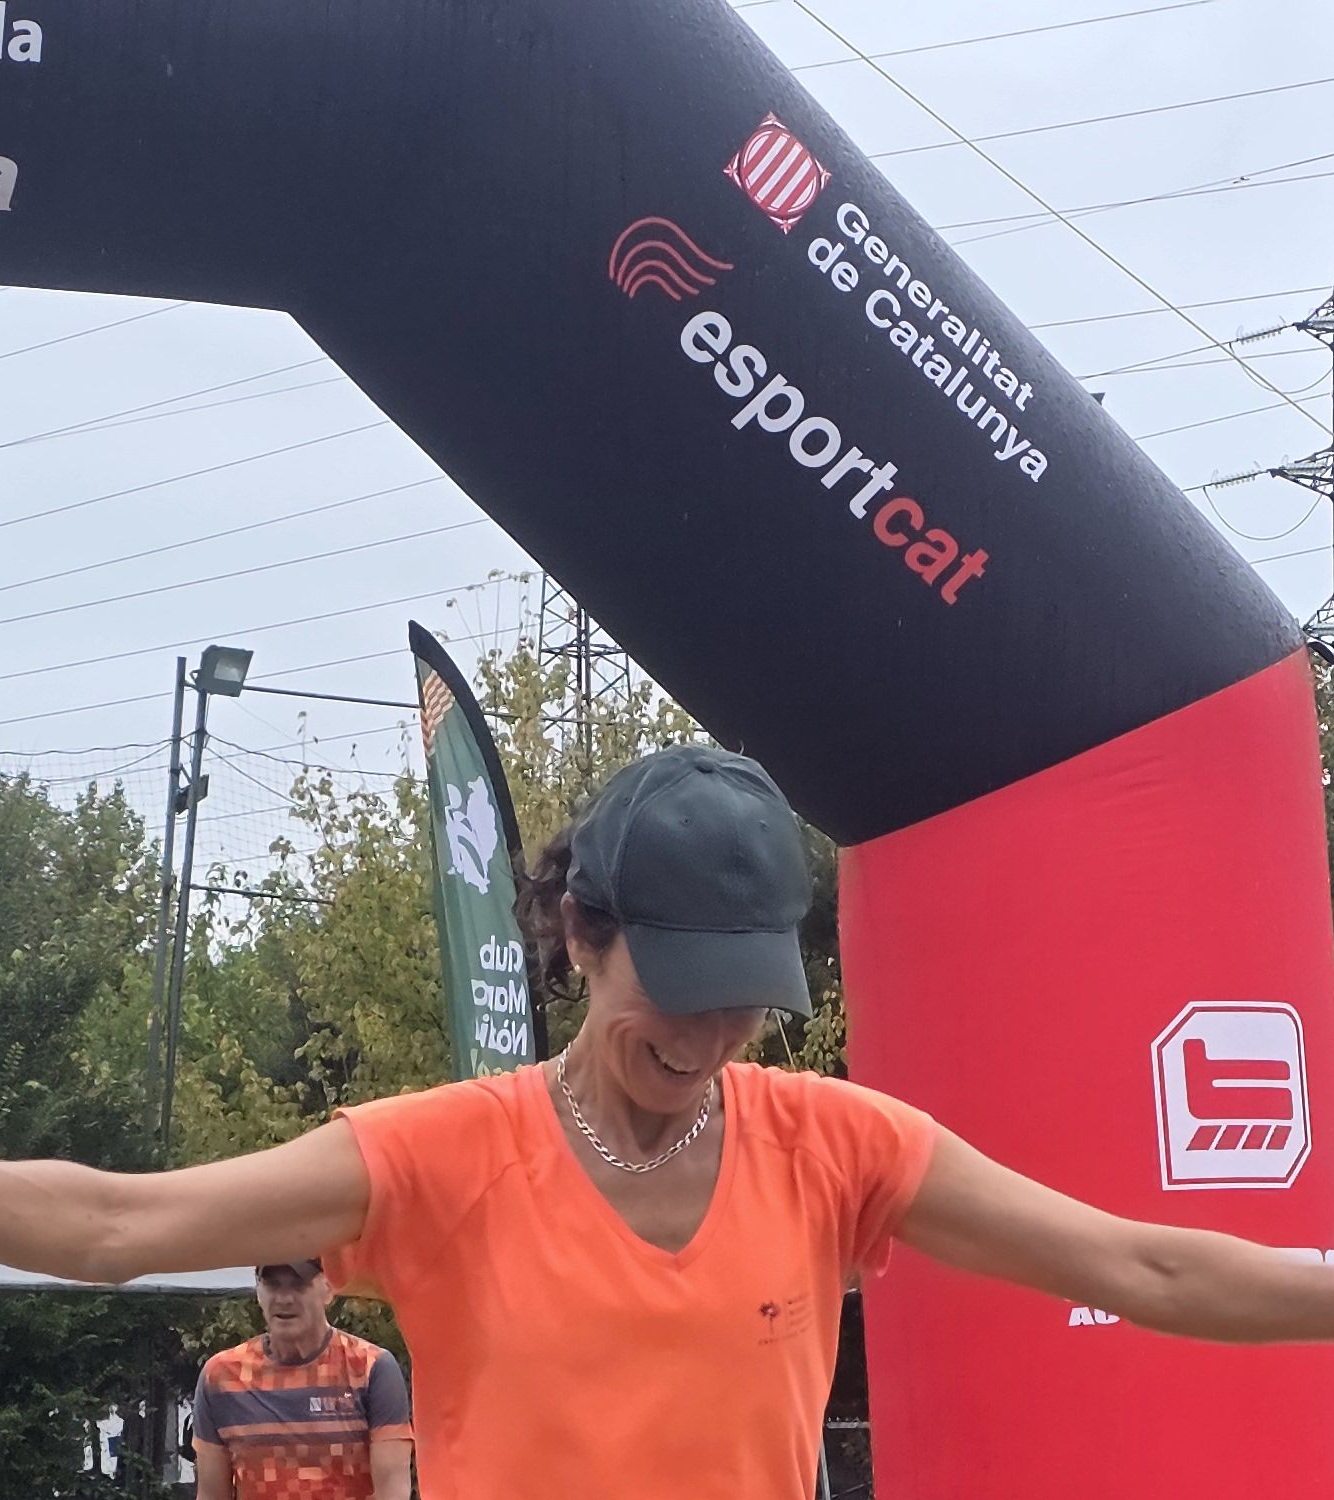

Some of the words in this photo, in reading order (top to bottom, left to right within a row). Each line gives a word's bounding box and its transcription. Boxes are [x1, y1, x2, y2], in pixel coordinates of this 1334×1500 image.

[807, 236, 859, 292] de
[865, 289, 1049, 483] Catalunya
[836, 202, 1034, 413] Generalitat
[680, 310, 990, 606] esportcat
